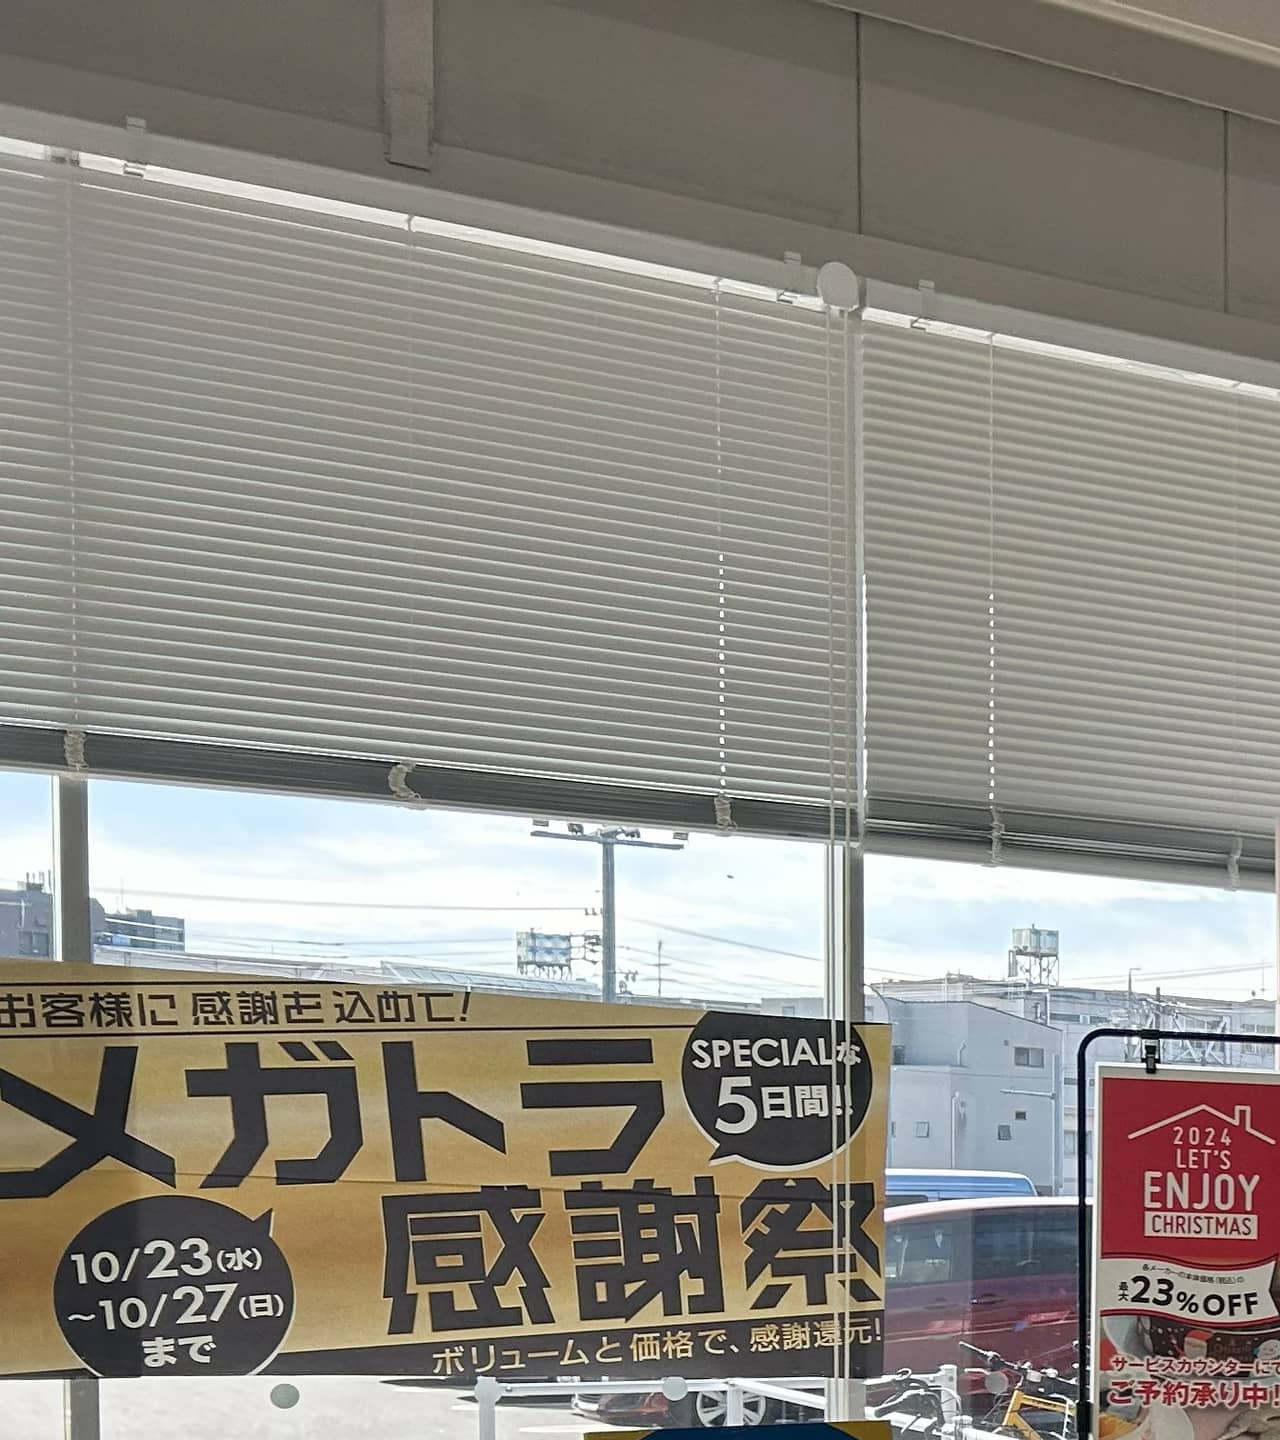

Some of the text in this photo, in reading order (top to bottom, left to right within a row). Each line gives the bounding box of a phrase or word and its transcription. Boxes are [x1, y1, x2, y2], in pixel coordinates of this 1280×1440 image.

[0, 1039, 665, 1198] メガトラ
[1172, 1127, 1232, 1147] 2024
[1176, 1149, 1232, 1170] LET'S
[1143, 1170, 1260, 1211] ENJOY
[1151, 1215, 1252, 1236] CHRISTMAS
[381, 1177, 884, 1335] 感謝祭
[141, 1335, 216, 1369] まで
